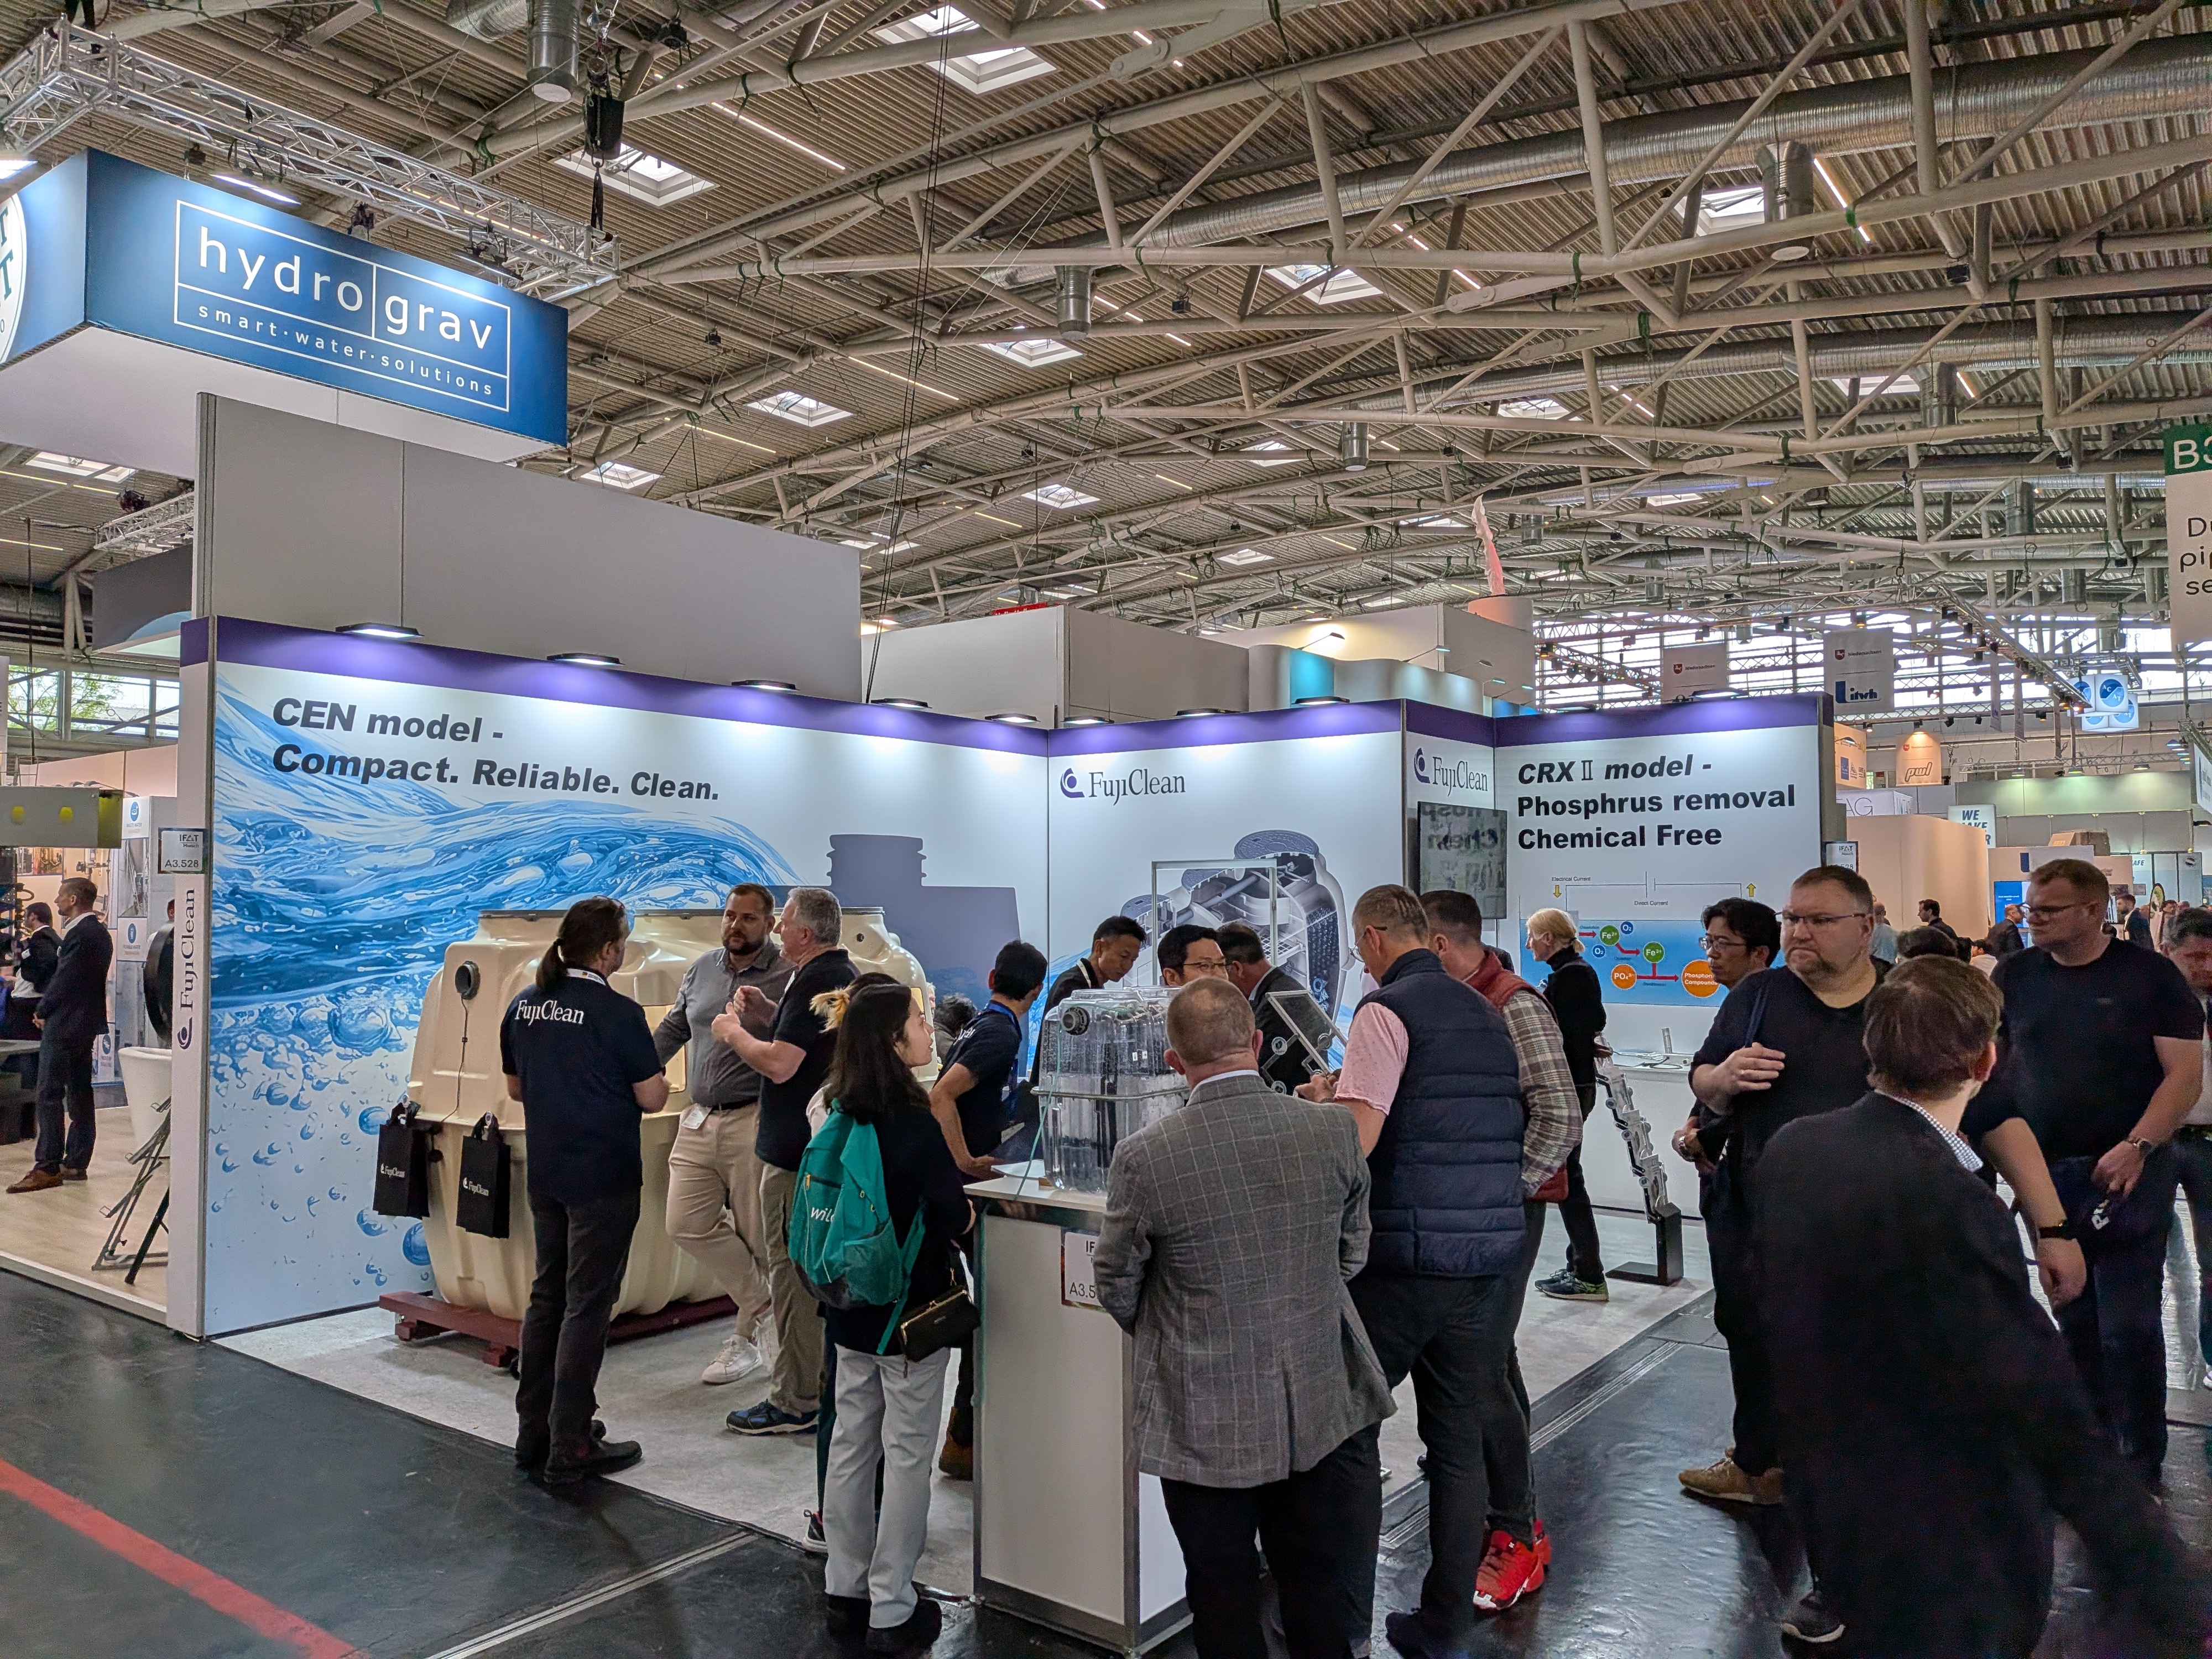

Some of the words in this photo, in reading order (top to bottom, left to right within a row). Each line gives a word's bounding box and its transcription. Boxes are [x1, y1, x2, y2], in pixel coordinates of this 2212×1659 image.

[2188, 517, 2212, 538] D
[2180, 546, 2212, 572] pi
[272, 697, 357, 732] CEN
[366, 713, 483, 743] model
[272, 744, 459, 785] Compact.
[472, 759, 620, 794] Reliable.
[629, 771, 720, 800] Clean.
[1432, 756, 1488, 797] FujiClean
[1604, 754, 1694, 780] model
[1088, 768, 1186, 806] FujiClean
[1517, 793, 1663, 820] Phosphrus
[1673, 784, 1795, 811] removal
[1962, 810, 1980, 820] WE
[1517, 826, 1646, 849] Chemical
[1657, 824, 1722, 846] Free
[165, 859, 199, 868] A3.528
[180, 888, 198, 1011] FujiClean
[514, 999, 585, 1026] FujiClean
[1086, 1240, 1095, 1253] IF
[1070, 1282, 1096, 1298] A3.5
